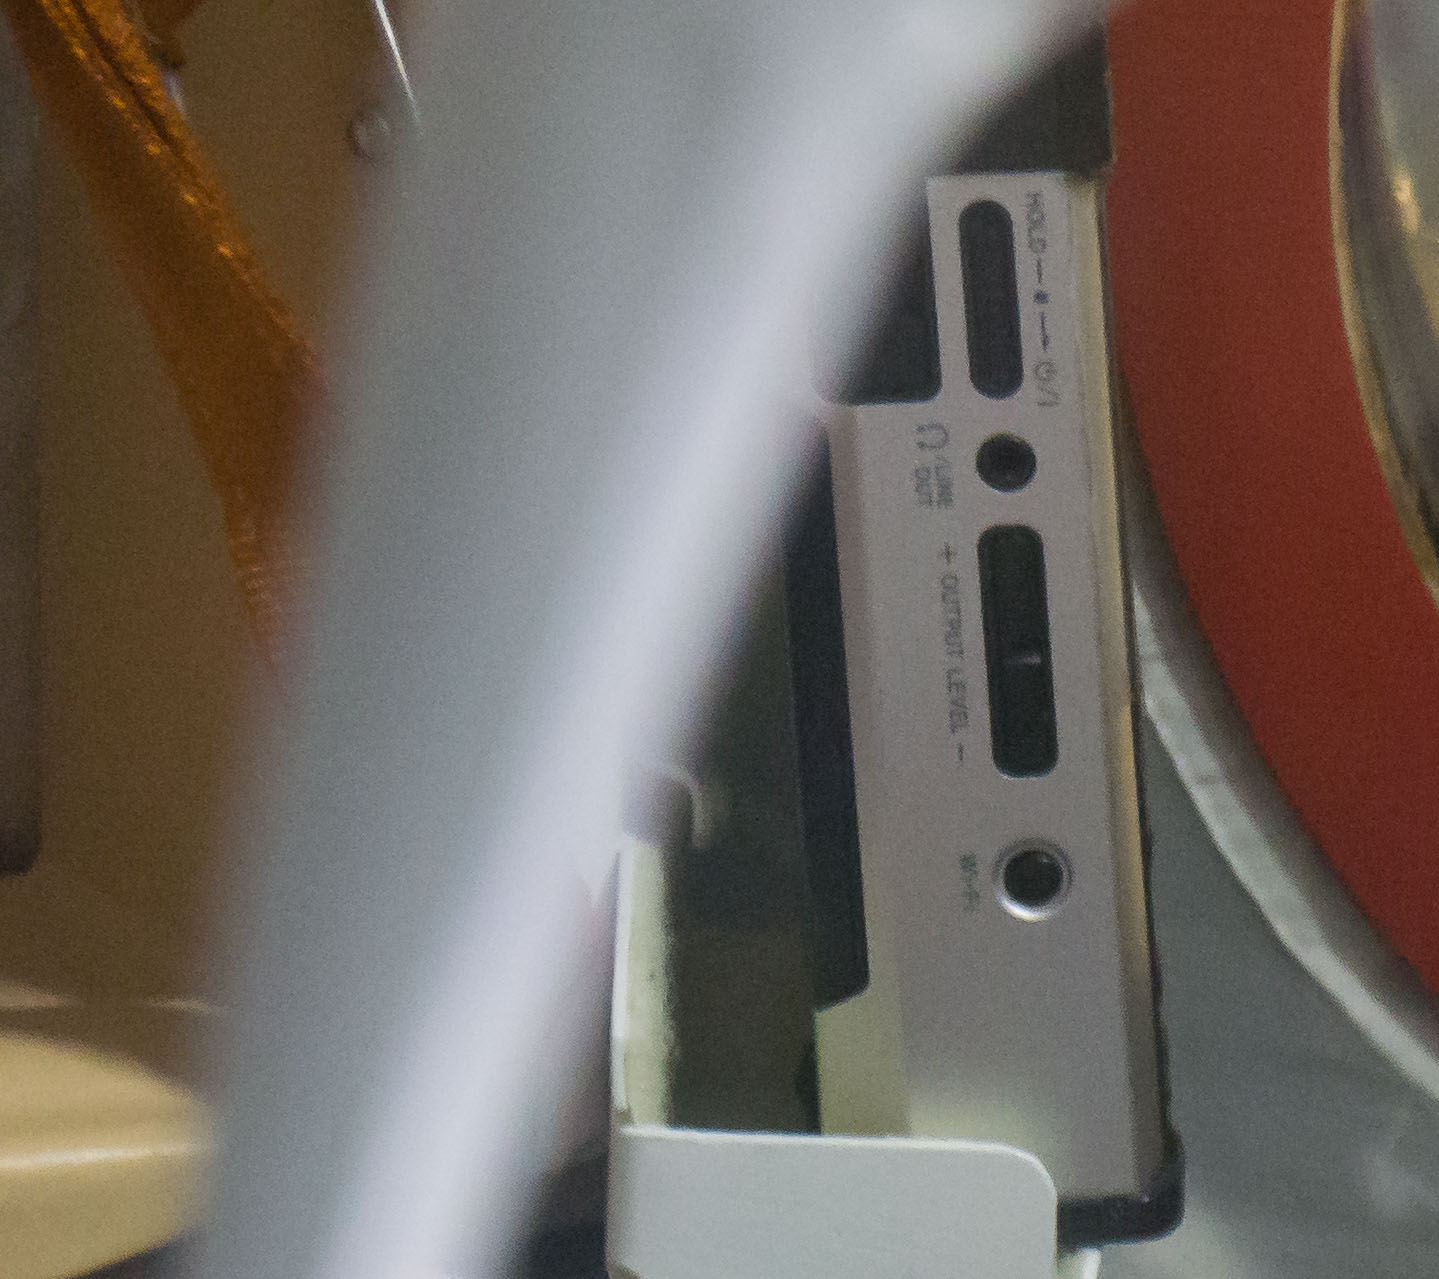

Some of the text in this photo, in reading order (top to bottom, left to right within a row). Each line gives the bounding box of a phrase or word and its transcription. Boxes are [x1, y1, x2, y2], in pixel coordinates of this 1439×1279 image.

[1026, 191, 1047, 252] HOLD
[940, 573, 969, 734] OUTPUT LEVEL
